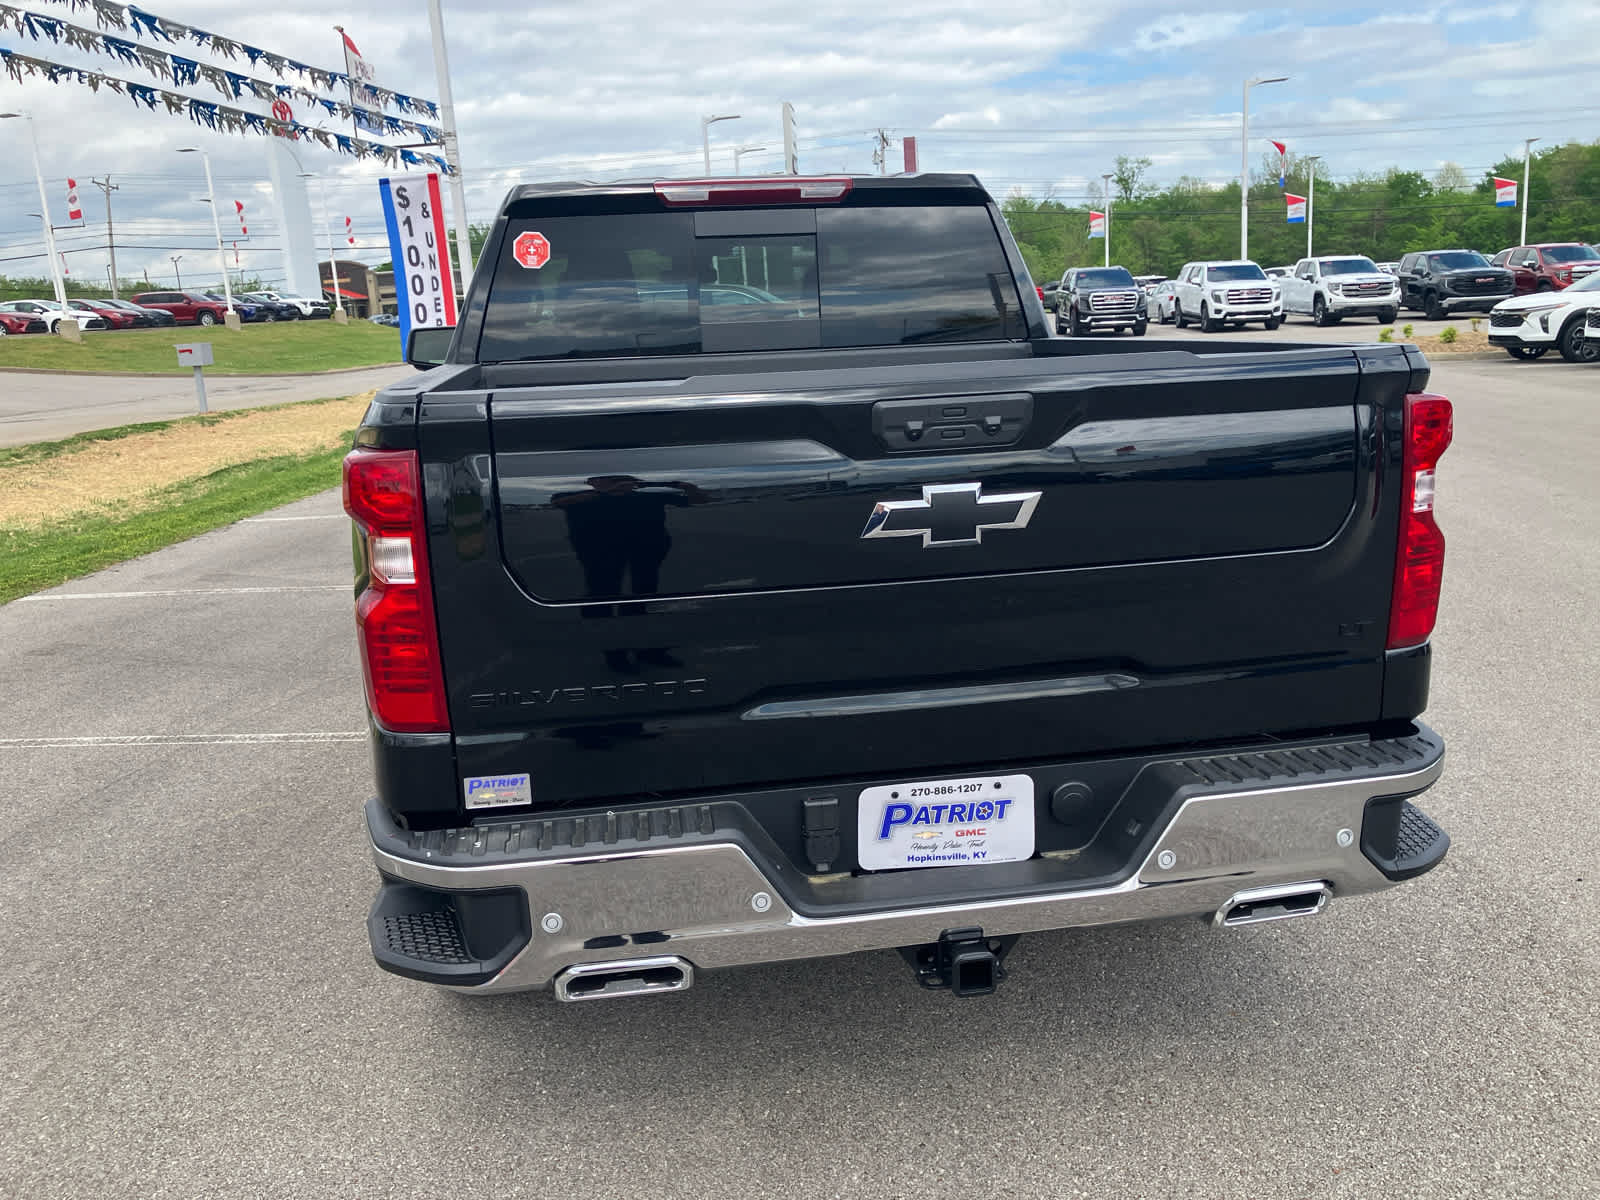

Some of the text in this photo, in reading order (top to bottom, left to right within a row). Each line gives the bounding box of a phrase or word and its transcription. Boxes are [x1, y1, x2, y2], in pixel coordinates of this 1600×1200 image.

[421, 202, 431, 219] &
[470, 678, 708, 707] SILVERADO
[468, 776, 527, 795] PATRIOT
[911, 783, 983, 797] 270-886-1207
[878, 799, 1012, 841] PATRIOT
[955, 828, 987, 837] GMC
[907, 852, 970, 864] Hopkinsville,
[973, 851, 988, 859] KY
